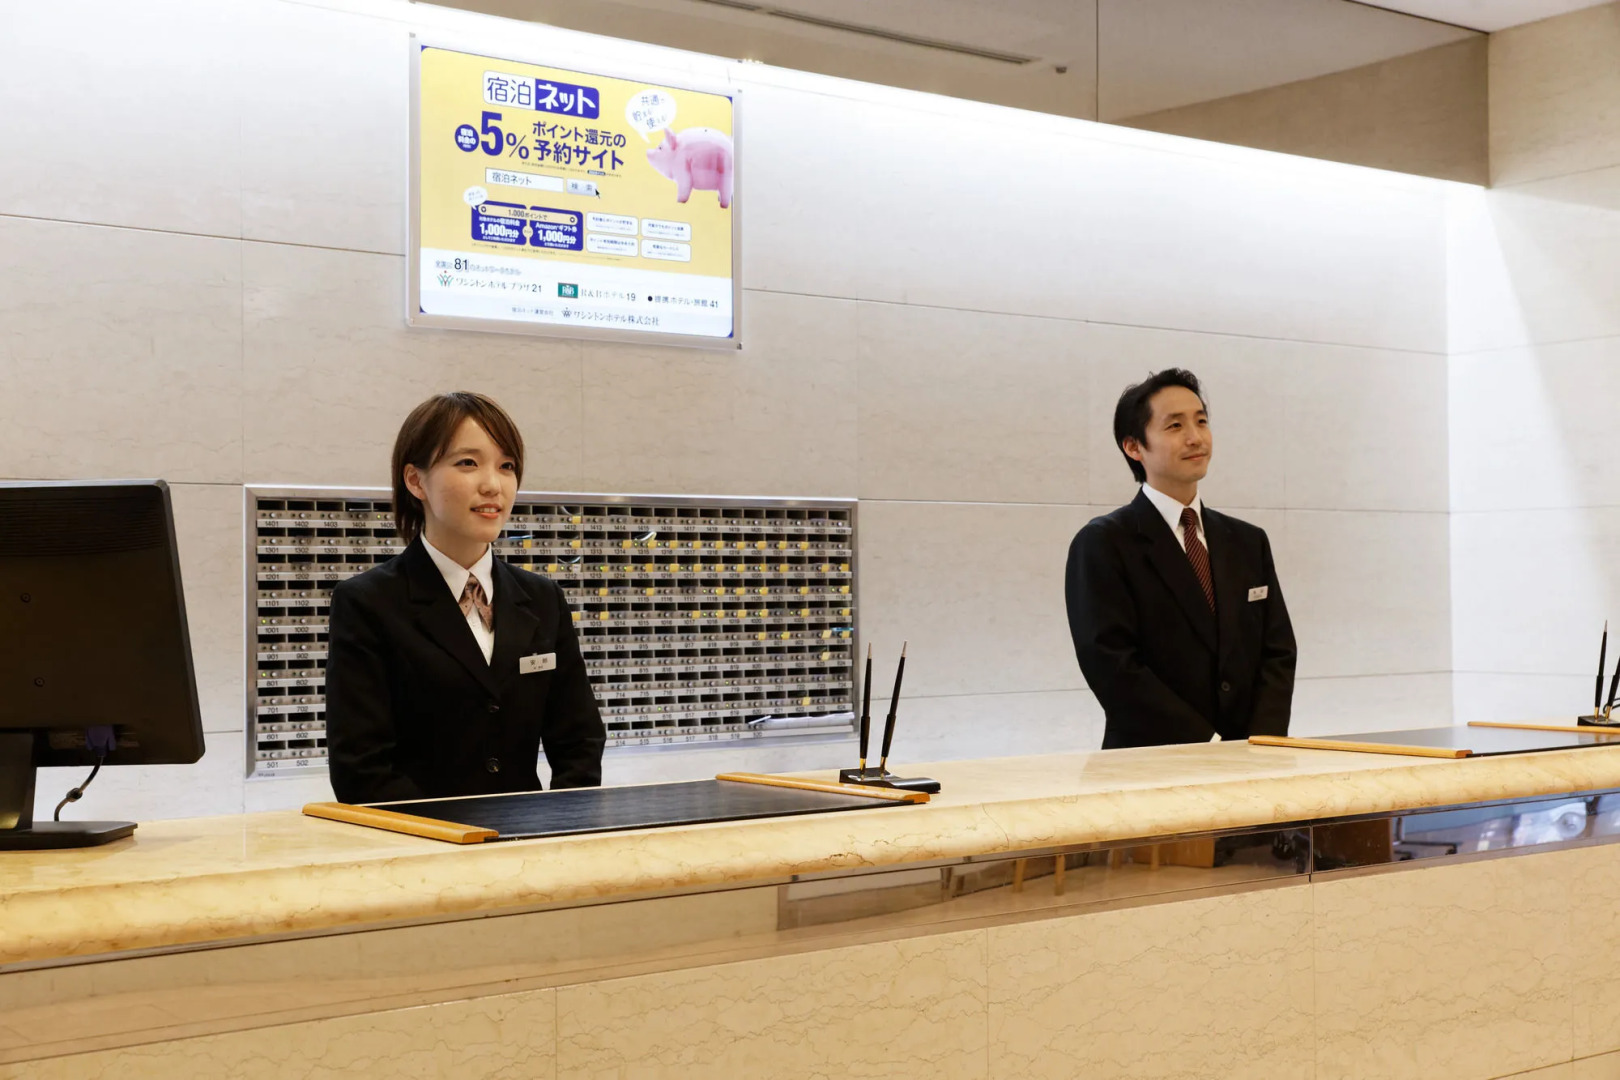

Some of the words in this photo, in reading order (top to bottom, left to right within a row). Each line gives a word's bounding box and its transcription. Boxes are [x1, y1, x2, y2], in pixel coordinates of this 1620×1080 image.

[487, 77, 597, 115] 宿泊ネット
[481, 110, 530, 160] 5%
[532, 121, 627, 148] ポイント還元の
[533, 139, 624, 170] 予約サイト
[491, 171, 532, 186] 宿泊ネット
[626, 292, 636, 302] 19
[573, 311, 660, 326] ワシントンホテル株式会社
